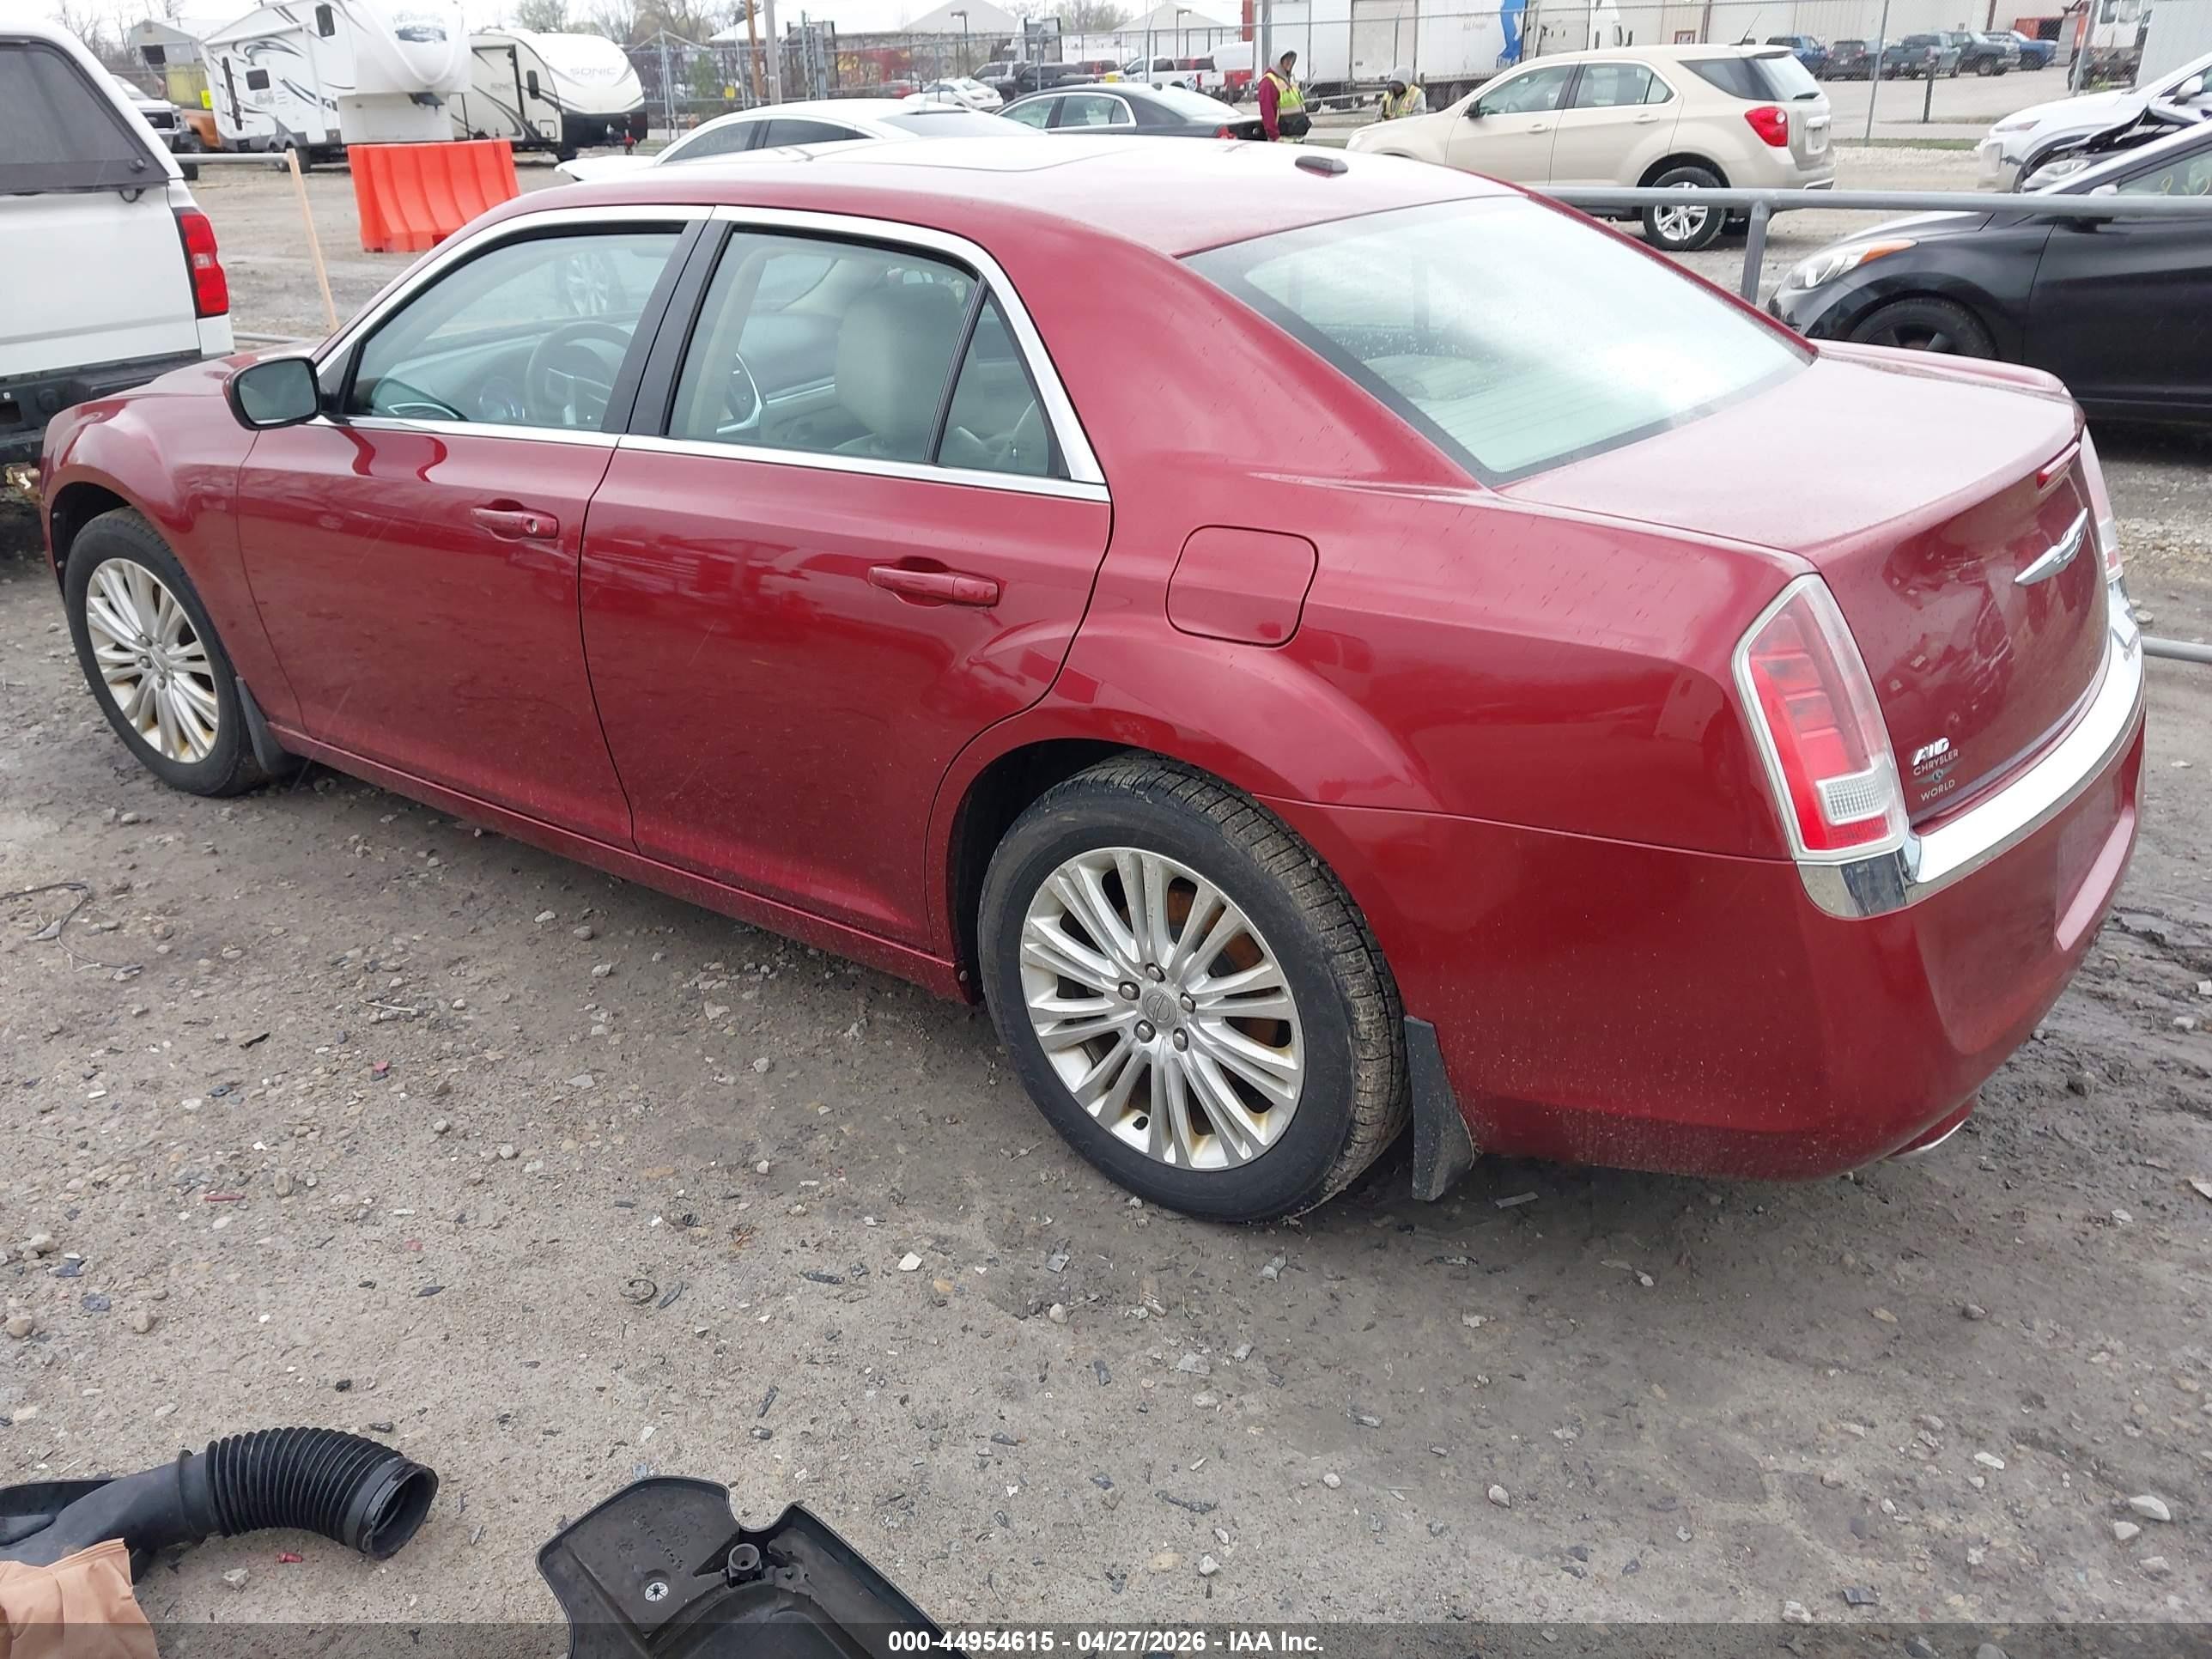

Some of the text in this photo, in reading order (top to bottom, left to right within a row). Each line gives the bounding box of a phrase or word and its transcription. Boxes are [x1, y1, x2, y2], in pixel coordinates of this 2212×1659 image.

[568, 66, 618, 76] SONIC
[1913, 749, 1959, 776] CHRYSLER
[1920, 779, 1955, 802] WORLD
